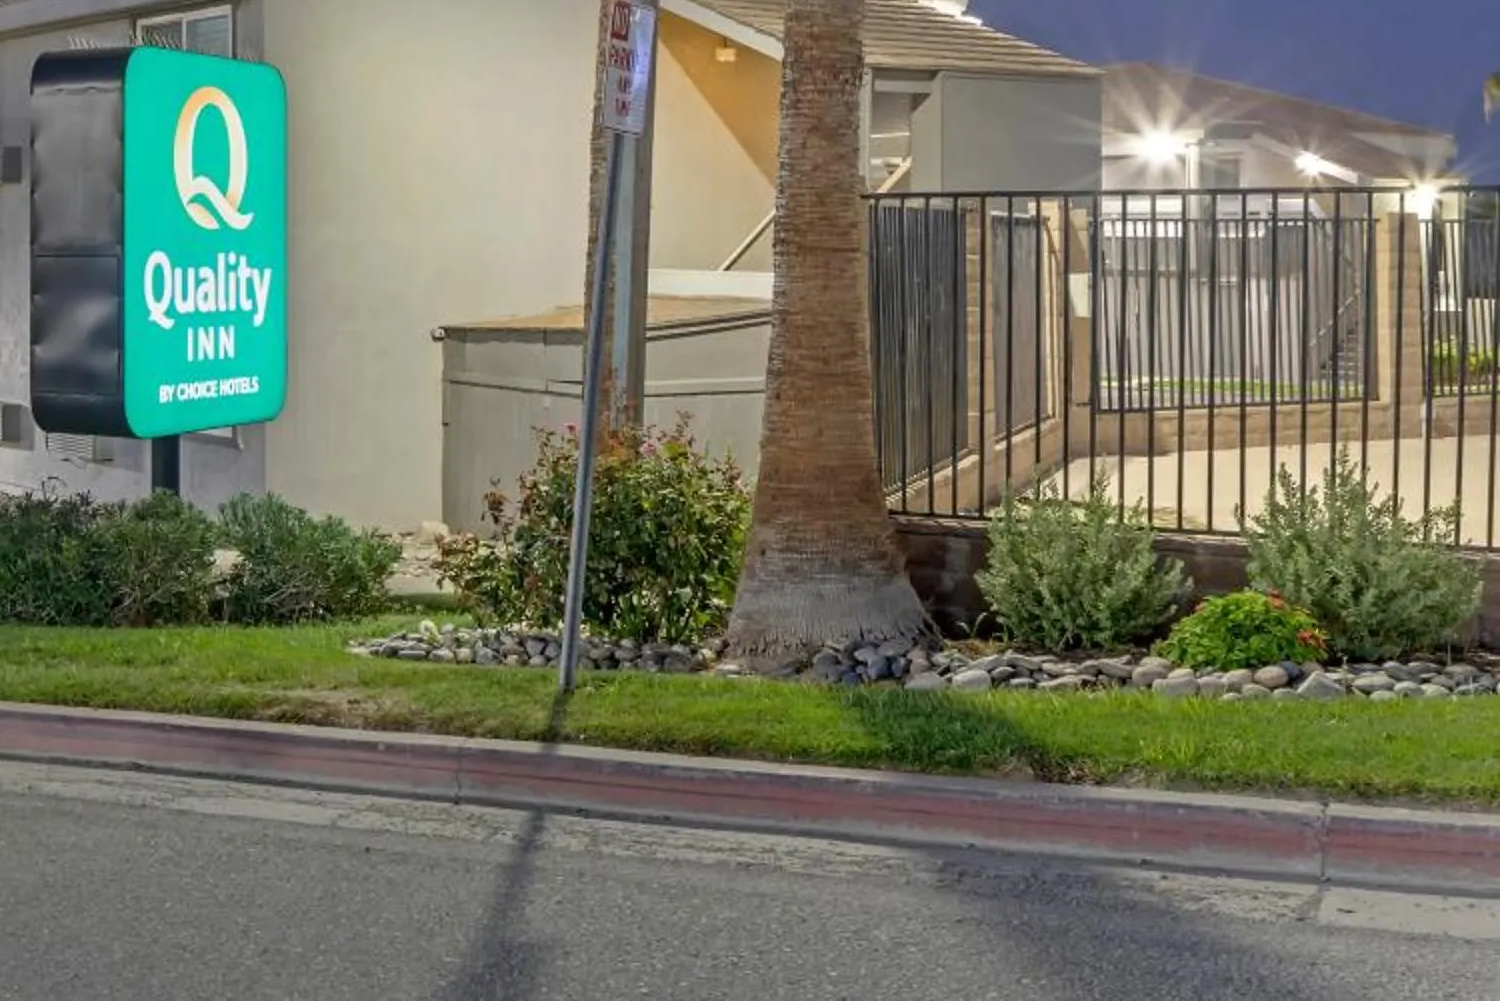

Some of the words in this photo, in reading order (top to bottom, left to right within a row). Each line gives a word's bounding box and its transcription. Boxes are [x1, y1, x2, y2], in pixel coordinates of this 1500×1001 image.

[173, 86, 255, 230] Q
[143, 250, 271, 330] Quality
[187, 324, 235, 361] INN
[158, 384, 175, 403] BY
[177, 380, 218, 401] CHOICE
[219, 376, 259, 396] HOTELS
